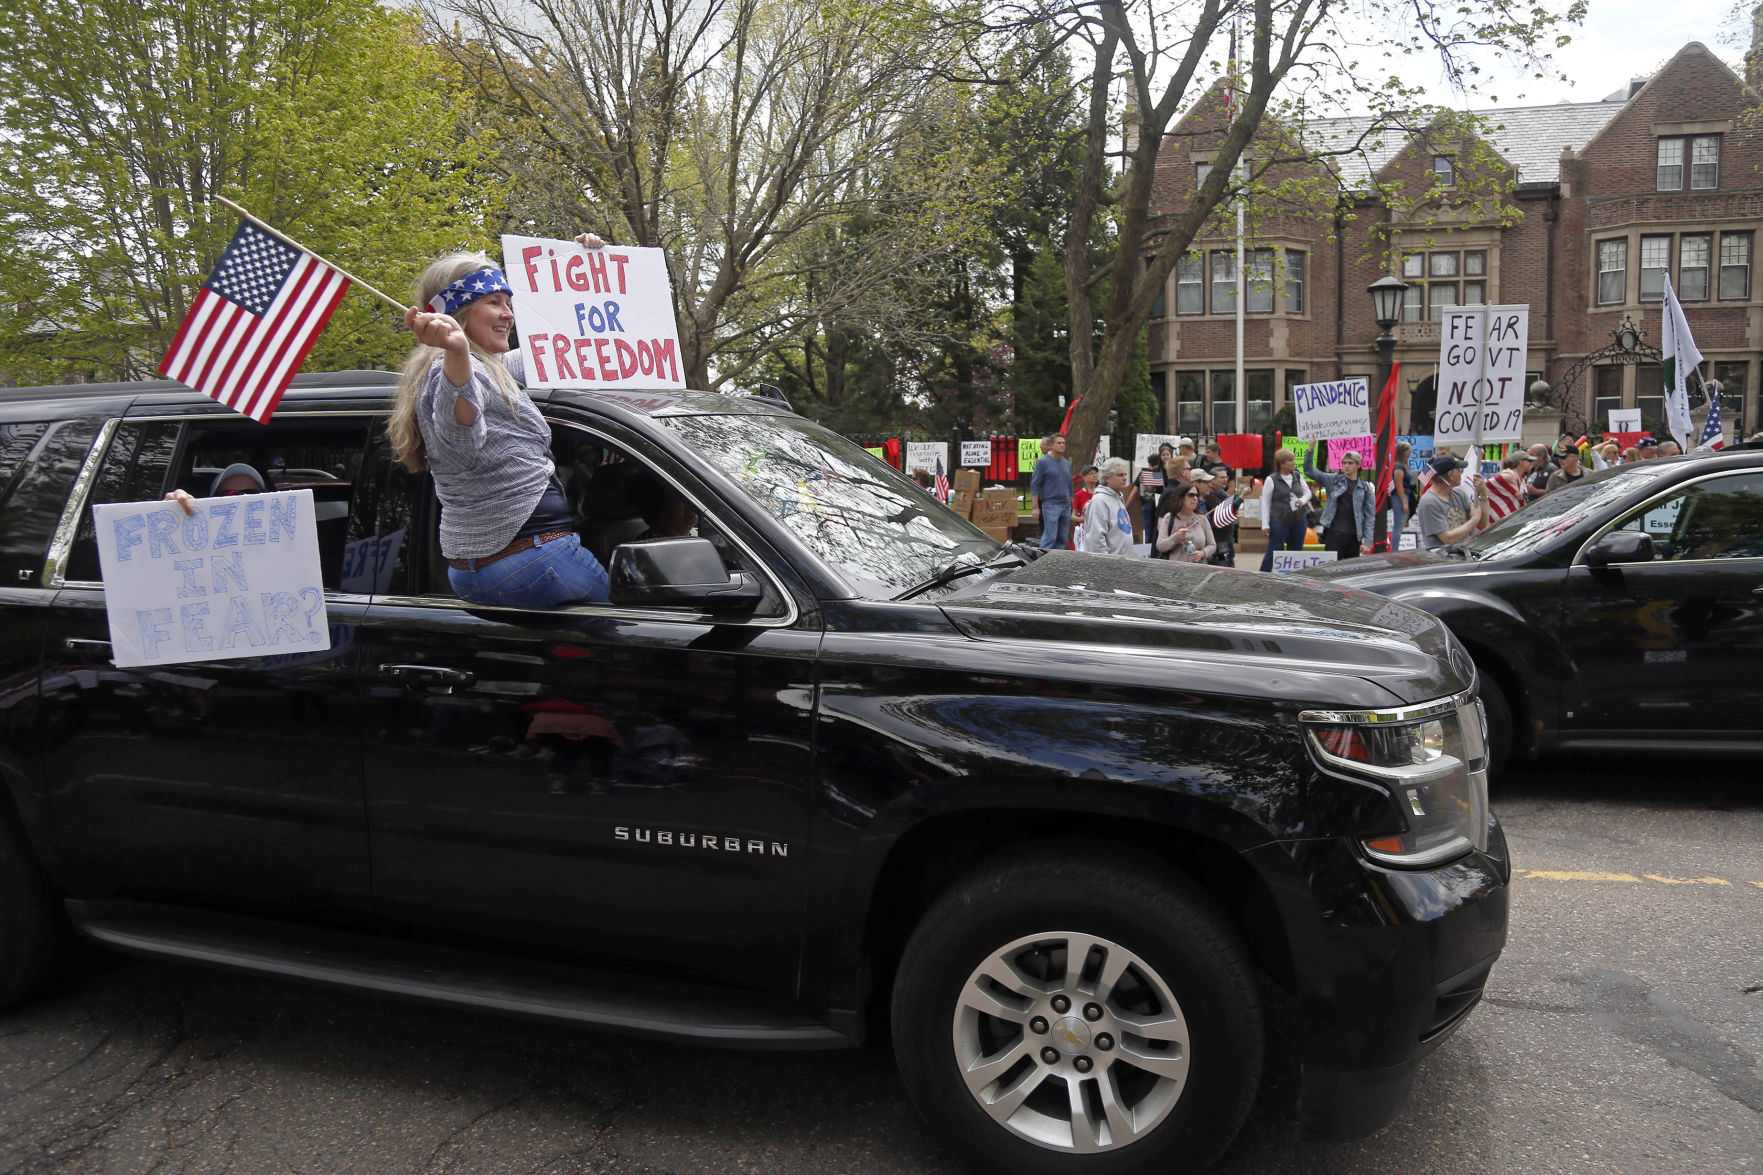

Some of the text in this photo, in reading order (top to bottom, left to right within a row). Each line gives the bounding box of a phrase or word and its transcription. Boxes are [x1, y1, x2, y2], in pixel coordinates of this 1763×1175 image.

[574, 300, 624, 336] FOR
[1451, 315, 1520, 342] FEAR
[529, 333, 680, 382] FREEDOM
[1447, 345, 1520, 368] GOVT
[1295, 382, 1367, 413] PLANDEMIC
[1448, 377, 1512, 405] NOT
[1438, 409, 1521, 434] COVID 19
[1329, 436, 1372, 451] Sweden
[963, 456, 990, 464] ESSENTIAL
[113, 495, 297, 562] FROZEN
[174, 552, 249, 599] IN
[135, 586, 323, 660] FEAR?
[614, 826, 788, 857] SUBURBAN
